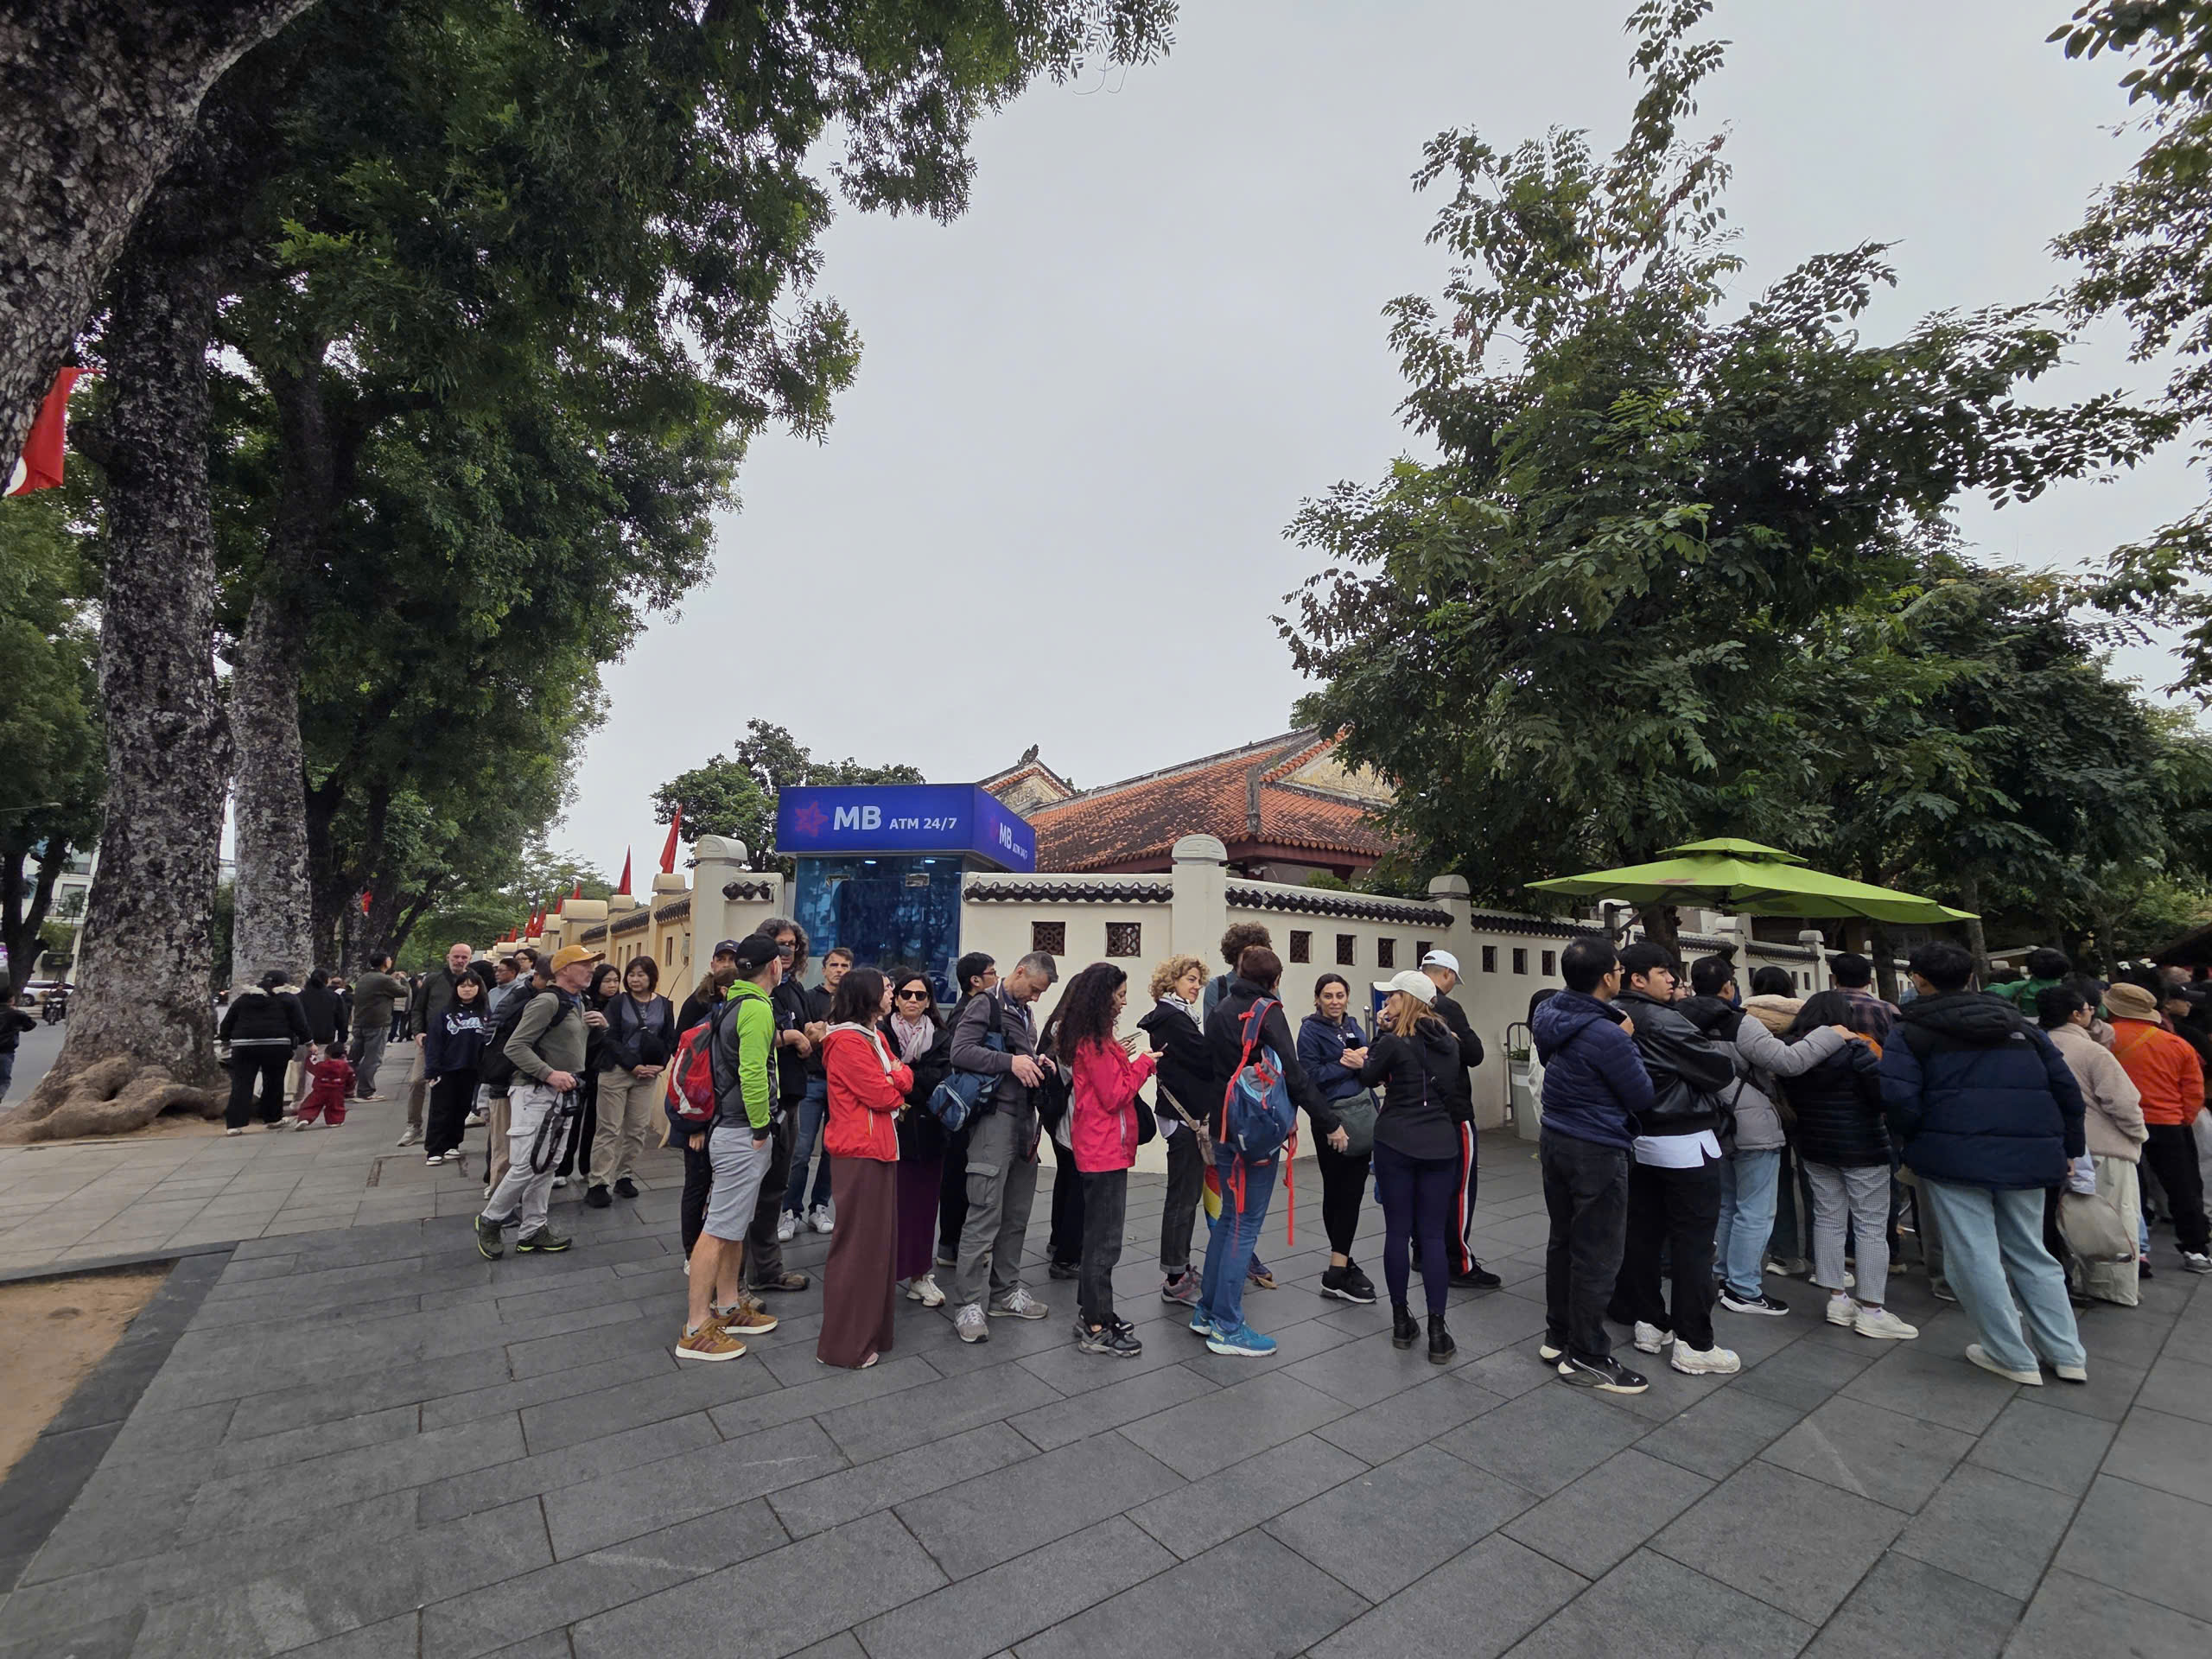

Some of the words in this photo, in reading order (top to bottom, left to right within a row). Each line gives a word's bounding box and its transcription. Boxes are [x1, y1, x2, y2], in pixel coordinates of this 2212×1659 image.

[833, 805, 881, 830] MB
[889, 818, 919, 830] ATM
[923, 817, 957, 831] 24/7
[999, 822, 1012, 850] MB
